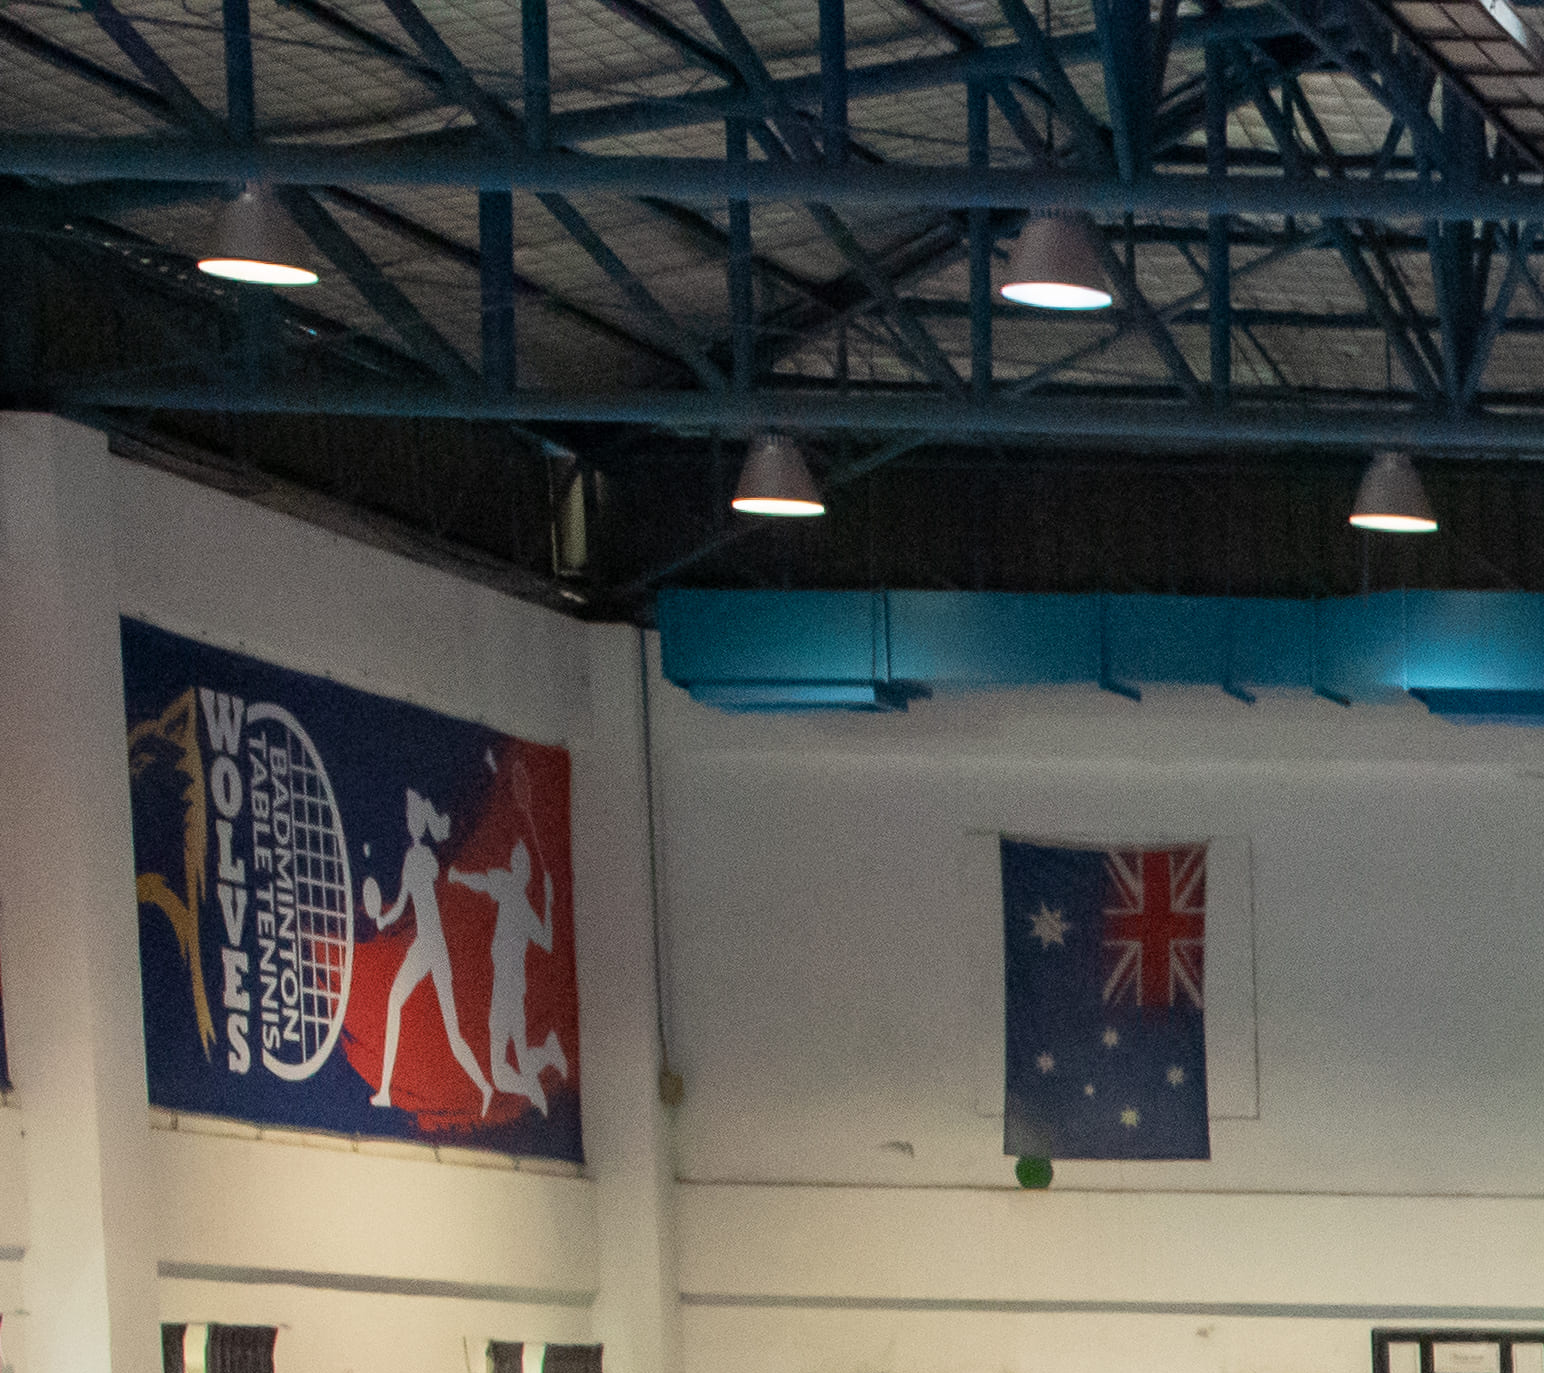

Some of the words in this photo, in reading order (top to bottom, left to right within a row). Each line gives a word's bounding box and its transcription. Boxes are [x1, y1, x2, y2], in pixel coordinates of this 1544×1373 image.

[200, 687, 252, 1075] WOLVES
[248, 731, 273, 872] TABLE
[269, 747, 300, 1042] BADMINTON
[255, 889, 281, 1051] TENNIS
